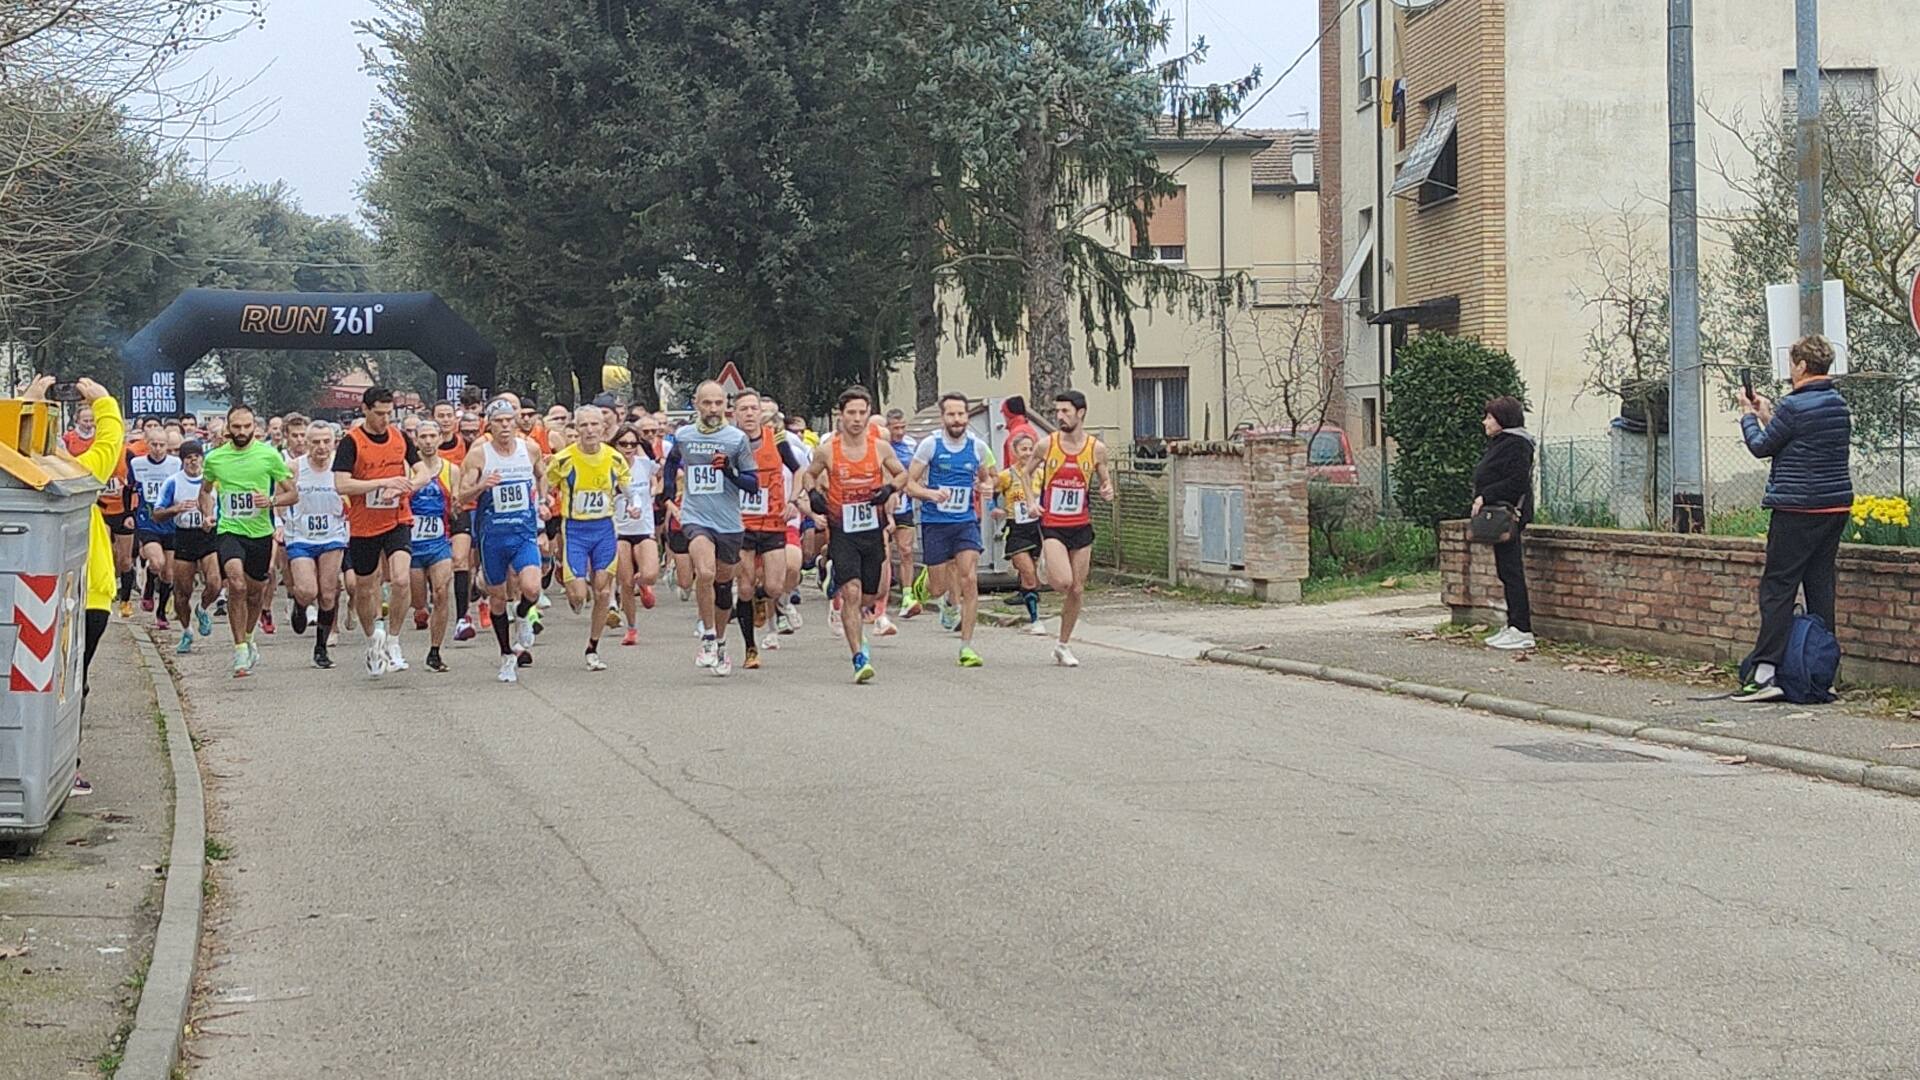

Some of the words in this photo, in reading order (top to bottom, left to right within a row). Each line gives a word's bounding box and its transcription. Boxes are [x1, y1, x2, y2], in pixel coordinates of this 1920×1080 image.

[240, 304, 327, 334] RUN
[152, 372, 176, 386] ONE
[446, 374, 468, 388] ONE
[132, 386, 176, 400] DEGREE
[132, 400, 177, 413] BEYOND
[694, 467, 717, 484] 649
[230, 493, 253, 509] 658
[500, 485, 522, 503] 698
[583, 492, 604, 508] 723
[1060, 490, 1079, 505] 781
[851, 503, 872, 522] 765
[308, 515, 329, 530] 633
[418, 517, 439, 533] 726
